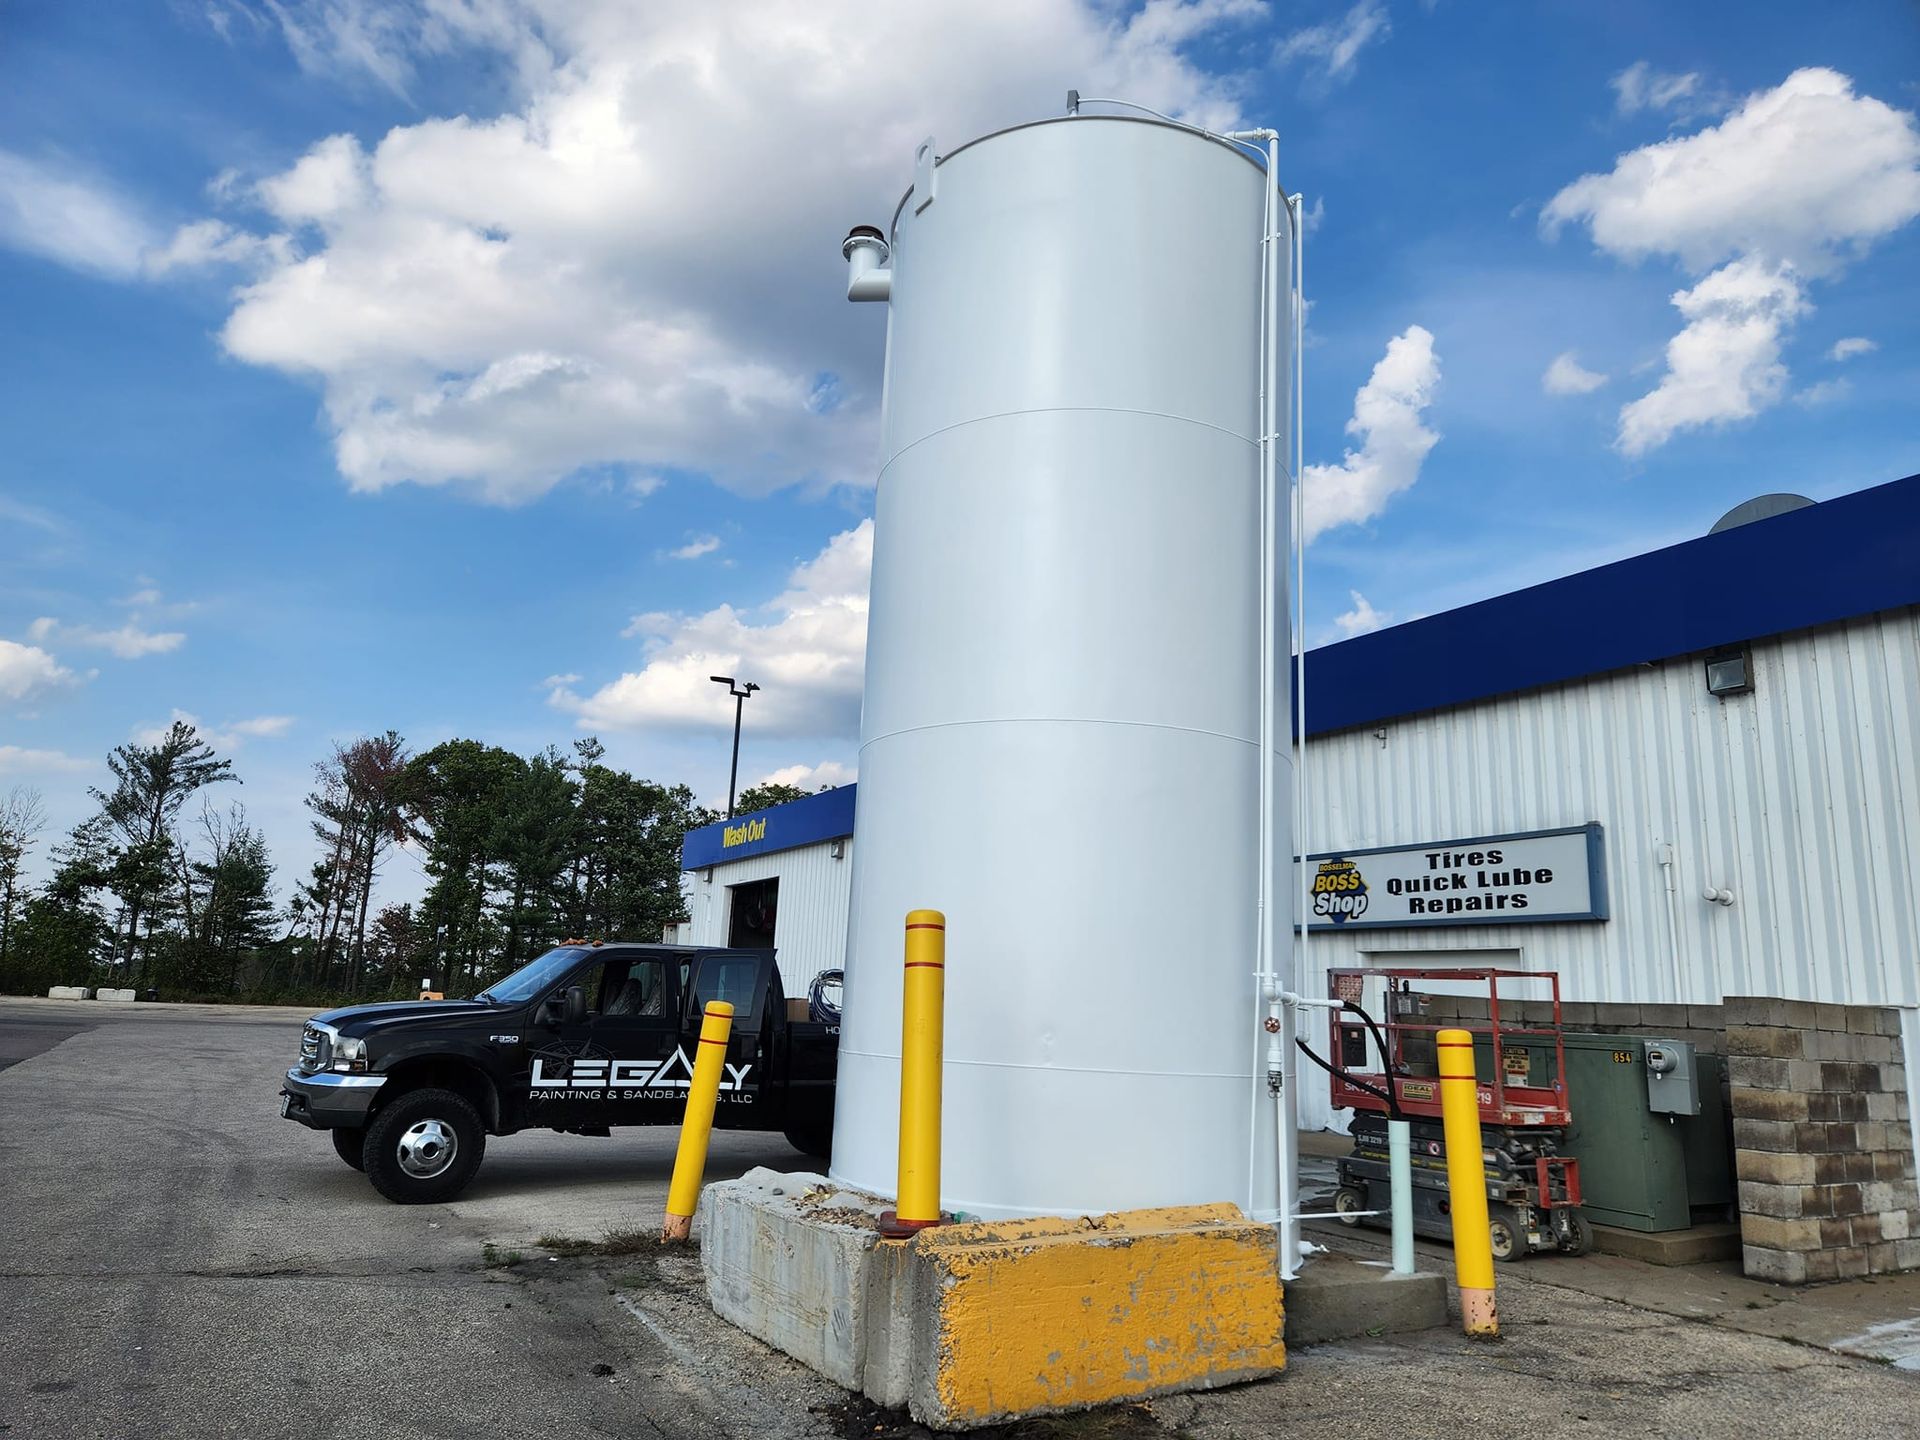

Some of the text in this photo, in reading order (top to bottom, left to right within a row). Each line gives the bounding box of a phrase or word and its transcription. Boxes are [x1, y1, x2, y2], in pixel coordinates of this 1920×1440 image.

[723, 818, 766, 847] Wash Out
[1425, 850, 1504, 870] Tires
[1315, 873, 1360, 892] BOSS
[1386, 867, 1554, 896] Quick Lube
[1315, 892, 1367, 917] Shop
[1409, 892, 1528, 914] Repairs
[530, 1042, 753, 1091] LEGAY
[1613, 1052, 1632, 1063] 854
[529, 1090, 601, 1100] PAINTING
[607, 1090, 617, 1100] &
[731, 1094, 753, 1105] LLC
